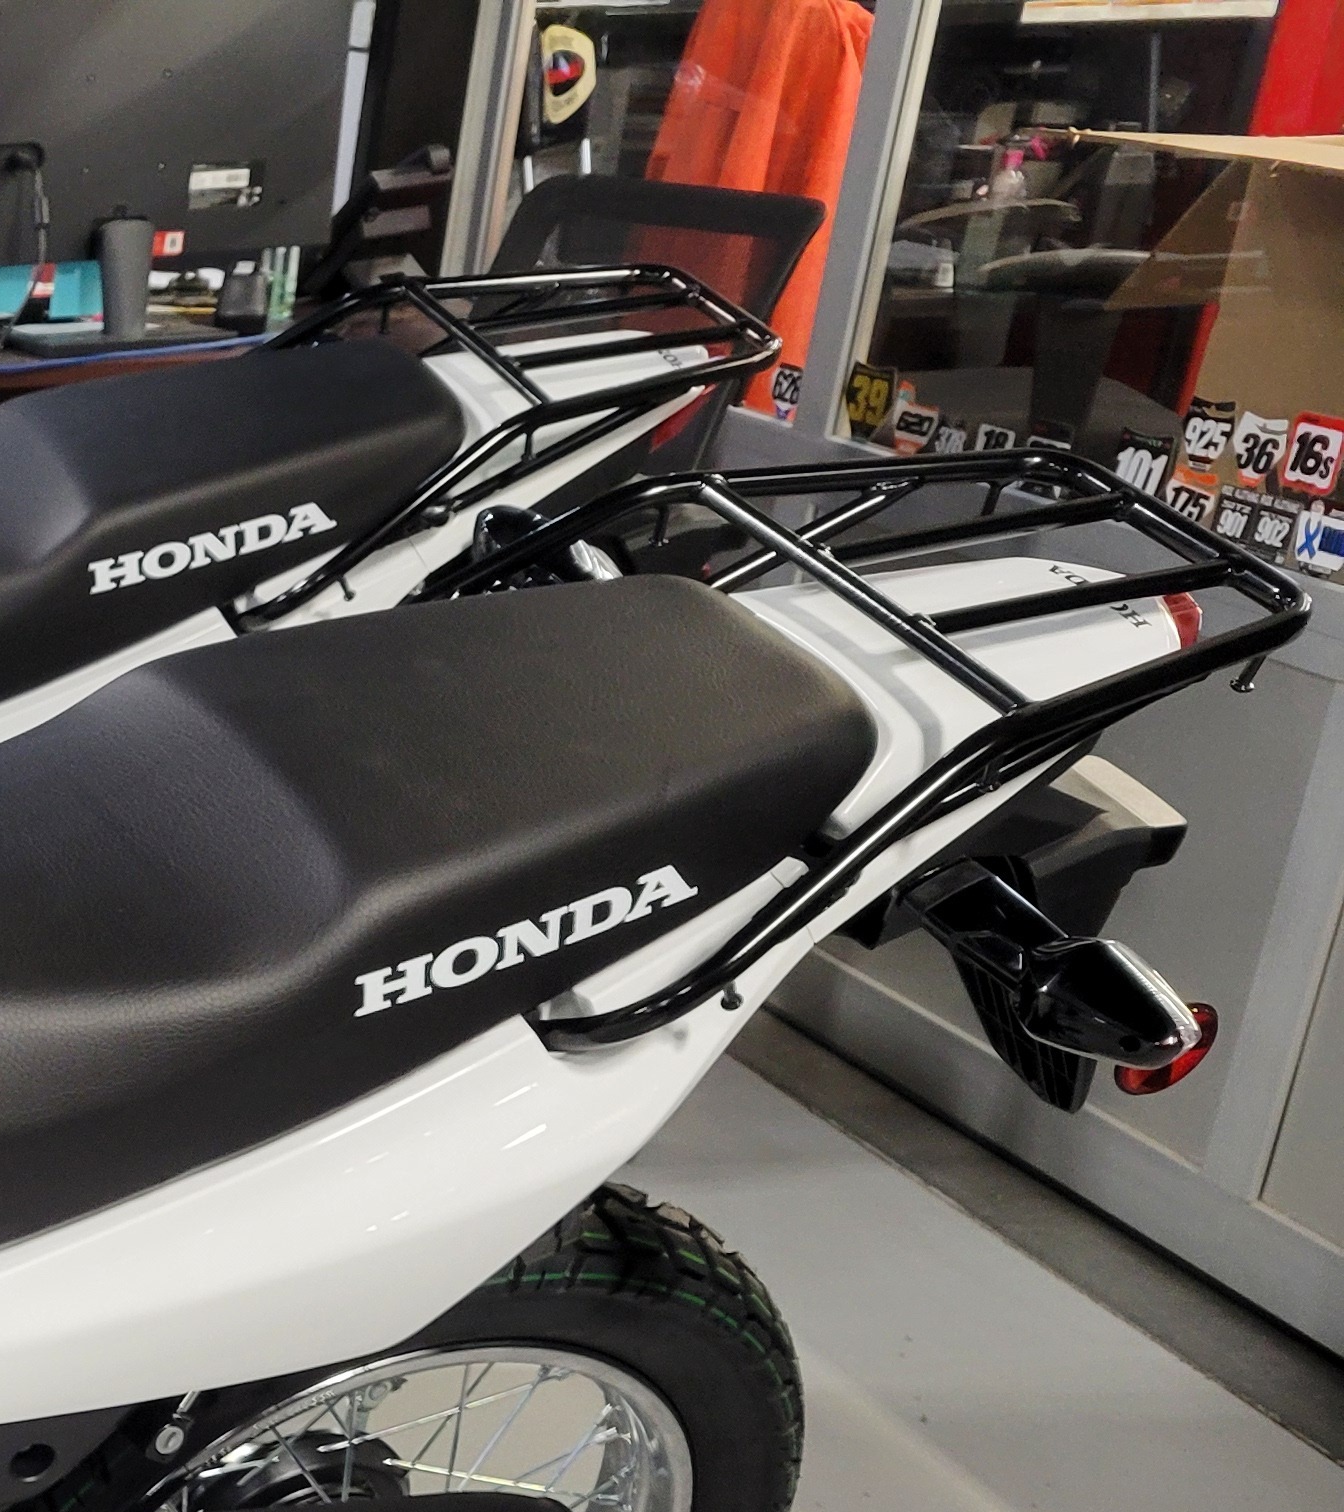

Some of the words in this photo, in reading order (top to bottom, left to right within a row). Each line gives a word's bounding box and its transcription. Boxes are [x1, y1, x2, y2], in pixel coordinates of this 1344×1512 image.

[850, 374, 890, 426] 39
[1185, 417, 1233, 459] 925
[1237, 433, 1280, 474] 36
[1115, 446, 1169, 496] 101
[1172, 486, 1210, 523] 175
[1217, 509, 1249, 538] 901
[88, 502, 337, 595] HONDA
[1254, 517, 1290, 547] 902
[1048, 564, 1153, 629] HDA
[354, 864, 699, 1017] HONDA
